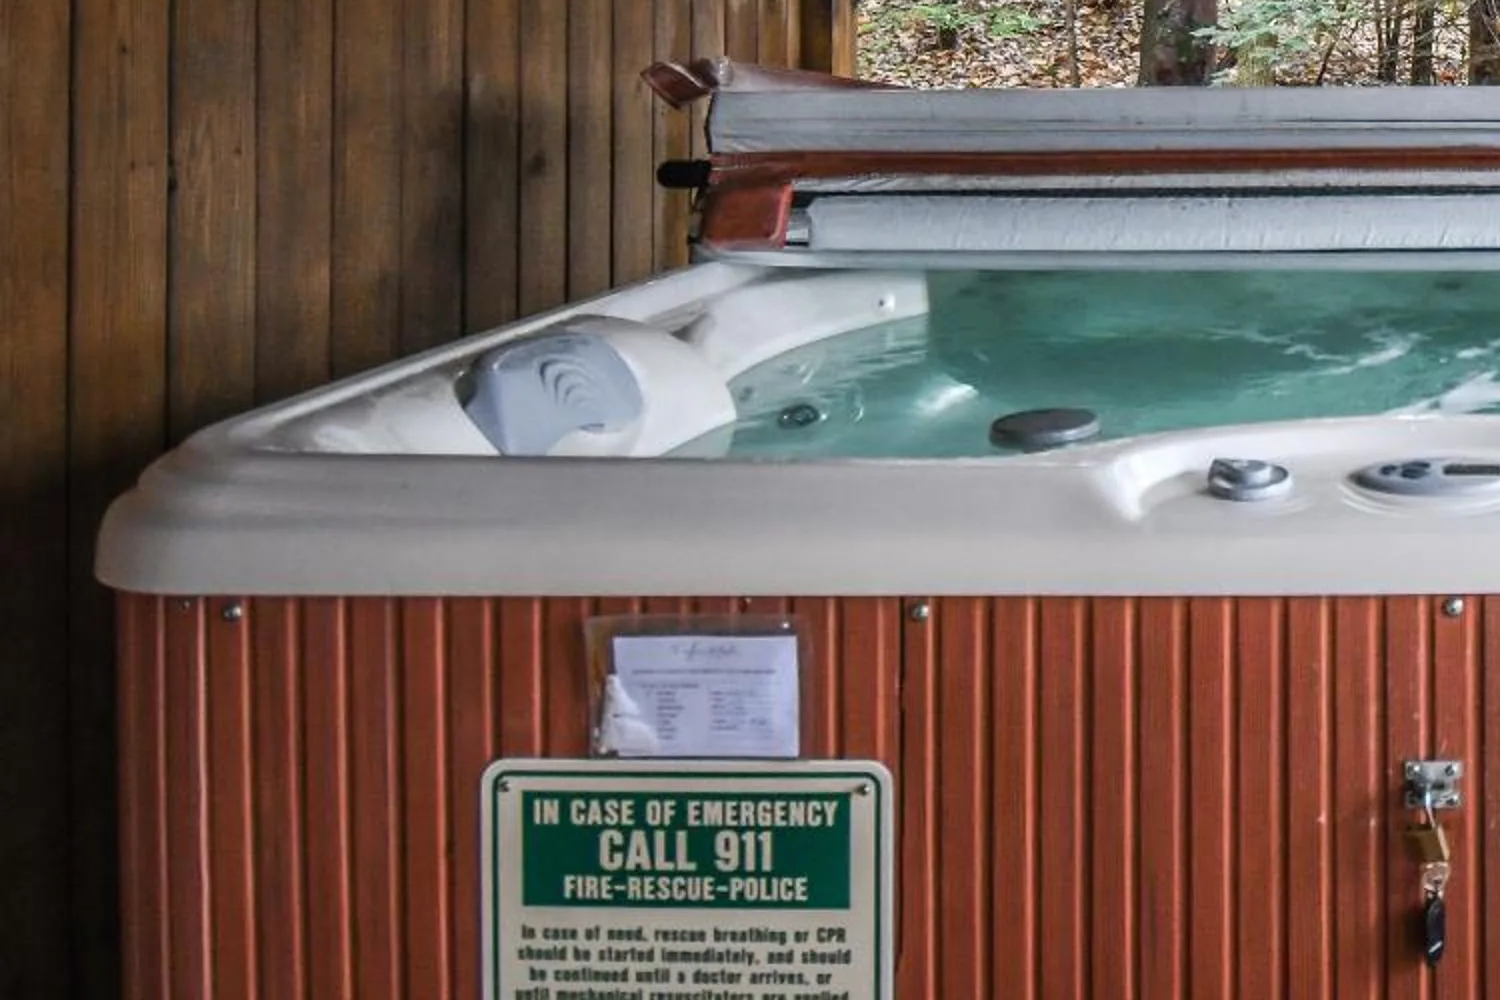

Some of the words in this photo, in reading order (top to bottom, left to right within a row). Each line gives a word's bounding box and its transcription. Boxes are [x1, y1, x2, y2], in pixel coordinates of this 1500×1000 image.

[533, 799, 558, 826] IN
[570, 799, 635, 826] CASE
[646, 799, 677, 826] OF
[687, 799, 839, 827] EMERGENCY
[599, 829, 697, 872] CALL
[714, 829, 774, 873] 911
[563, 875, 809, 902] FIRE-RESCUE-POLICE
[520, 925, 536, 941] In
[542, 927, 578, 941] case
[585, 925, 601, 941] of
[653, 929, 706, 942] rescue
[713, 927, 787, 945] breathing
[794, 930, 810, 943] or
[816, 927, 847, 943] CPR
[517, 945, 567, 961] should
[573, 946, 591, 962] be
[598, 946, 655, 962] started
[767, 949, 794, 964] and
[801, 948, 852, 965] should
[528, 966, 547, 982] be
[553, 967, 629, 983] continued
[635, 968, 670, 983] until
[677, 971, 686, 984] a
[693, 968, 742, 984] doctor
[816, 972, 833, 985] or
